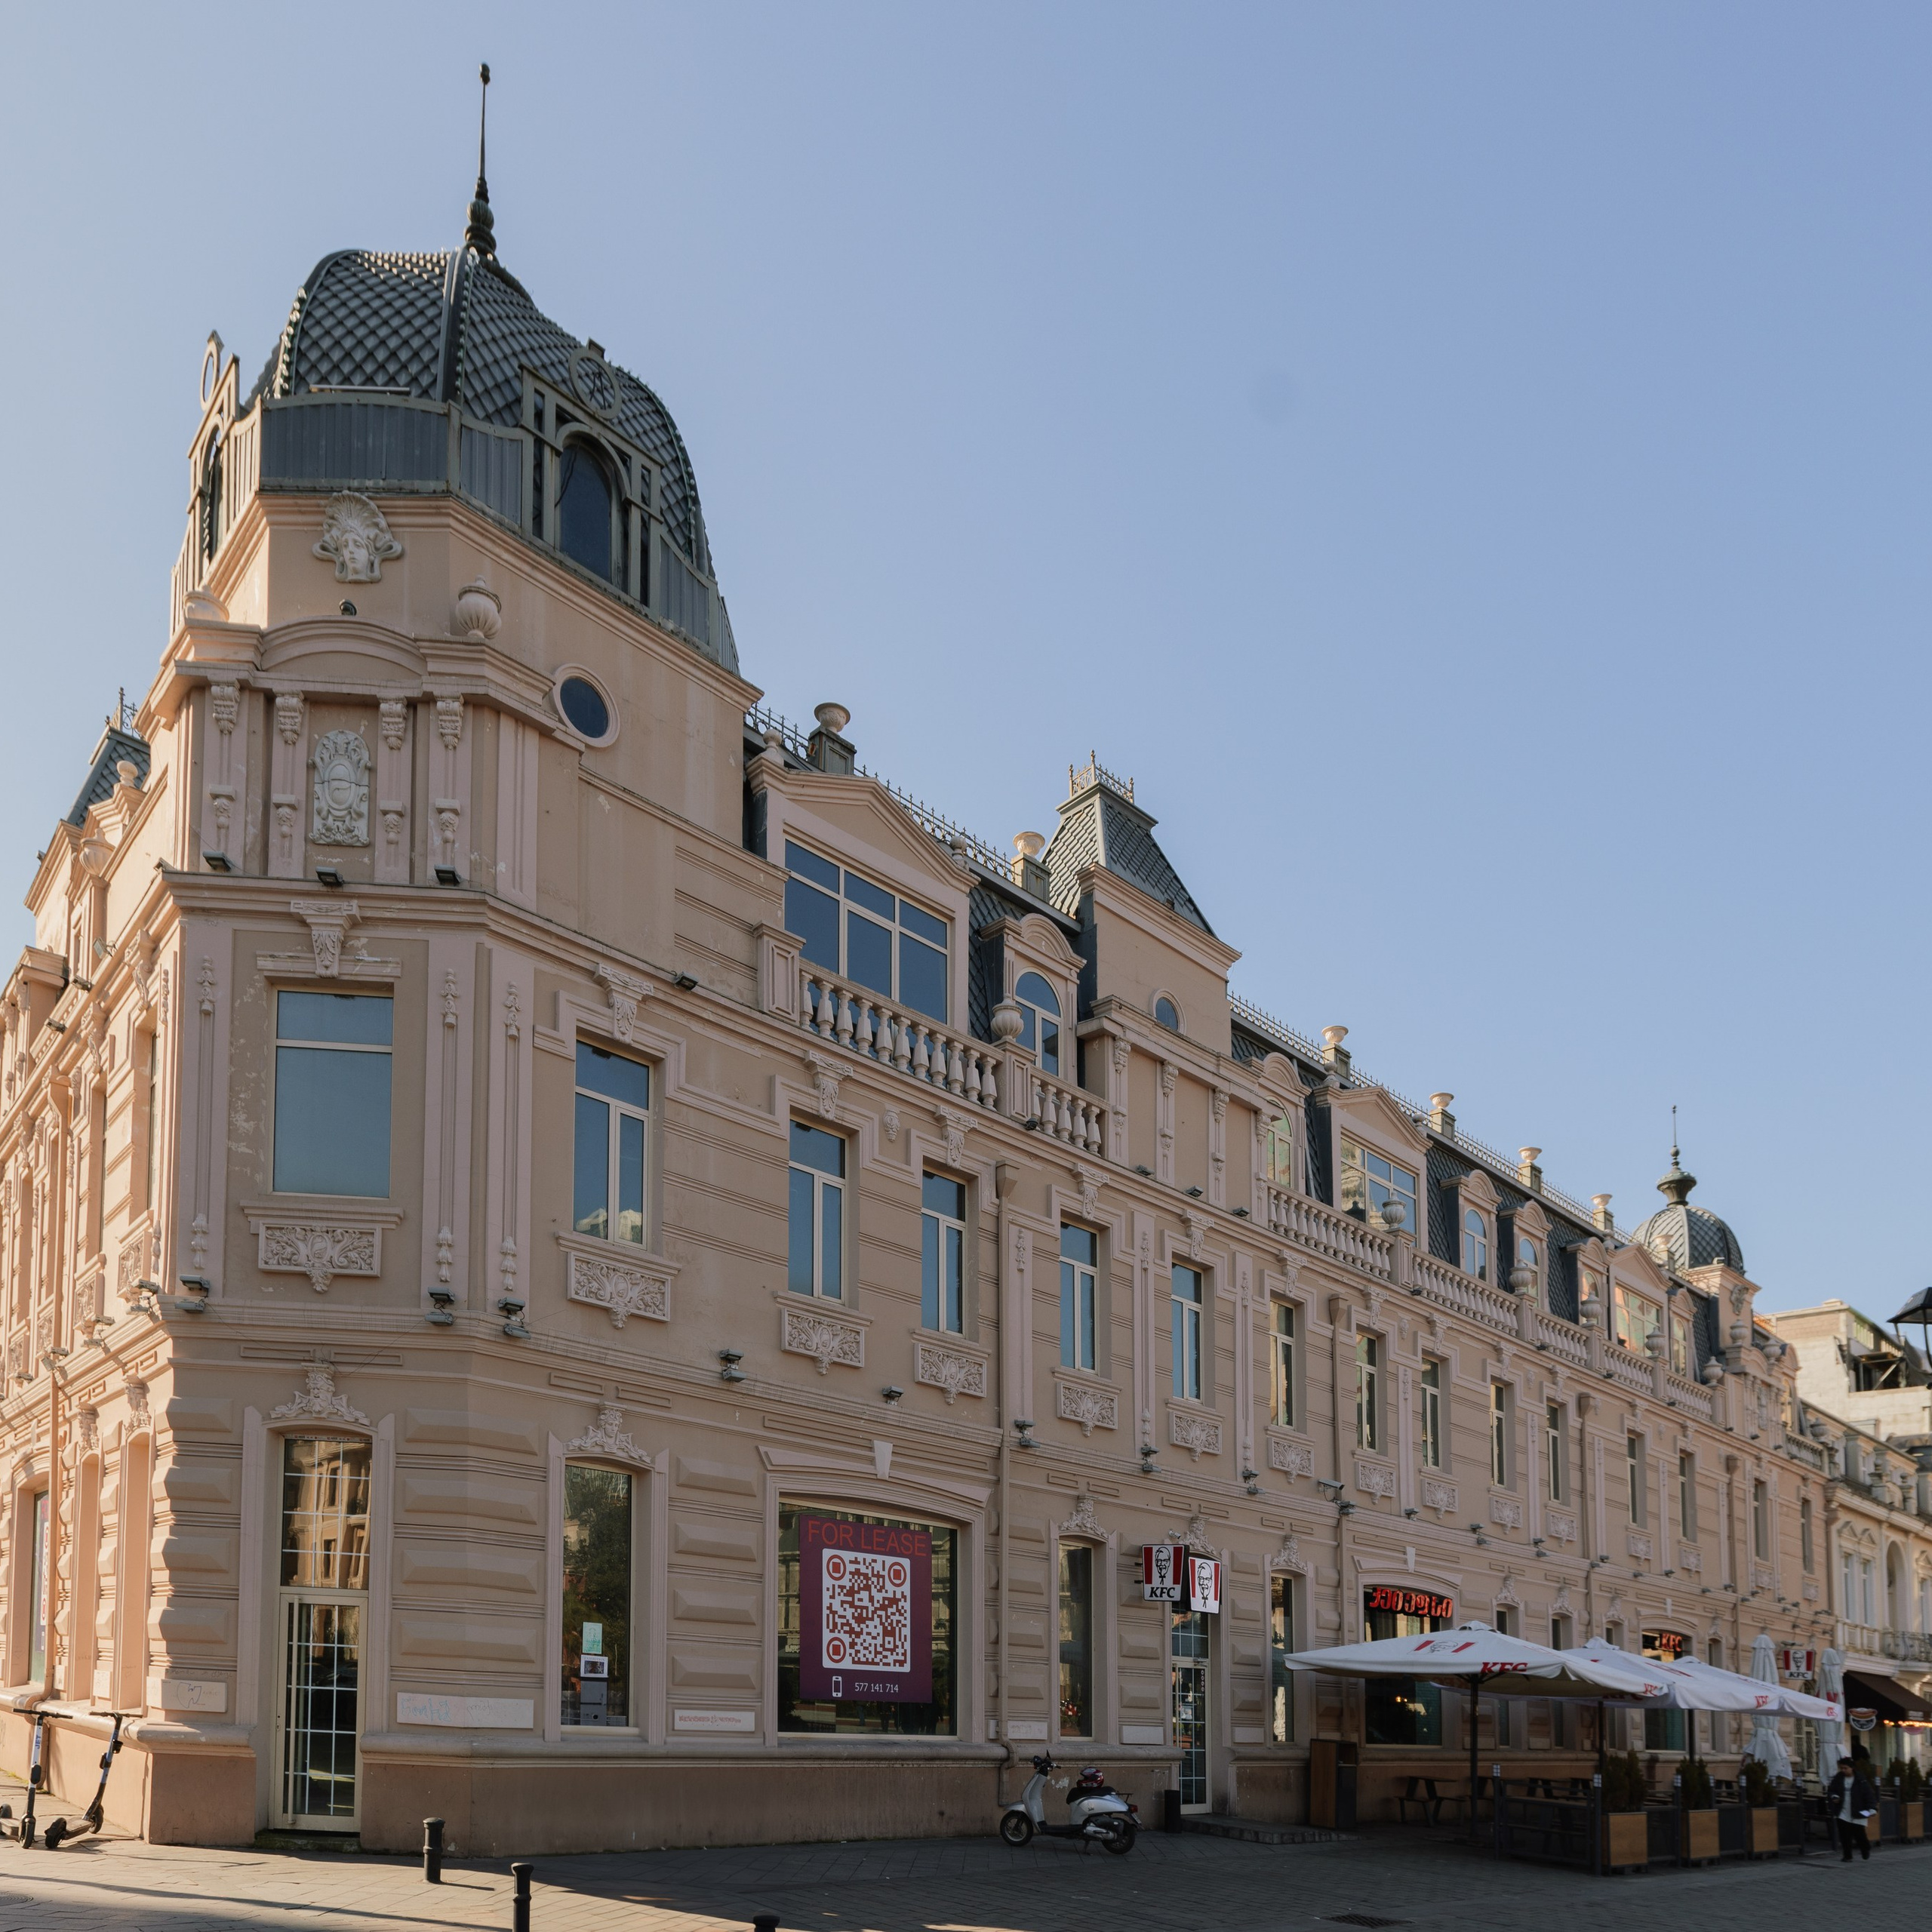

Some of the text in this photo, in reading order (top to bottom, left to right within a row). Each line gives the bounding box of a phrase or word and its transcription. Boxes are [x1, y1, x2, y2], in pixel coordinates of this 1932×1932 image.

[808, 1520, 927, 1556] FOR LEASE
[1149, 1587, 1175, 1598] KFC
[1662, 1632, 1682, 1651] KFC
[1480, 1662, 1528, 1674] KFC
[855, 1682, 899, 1693] 577 141 714
